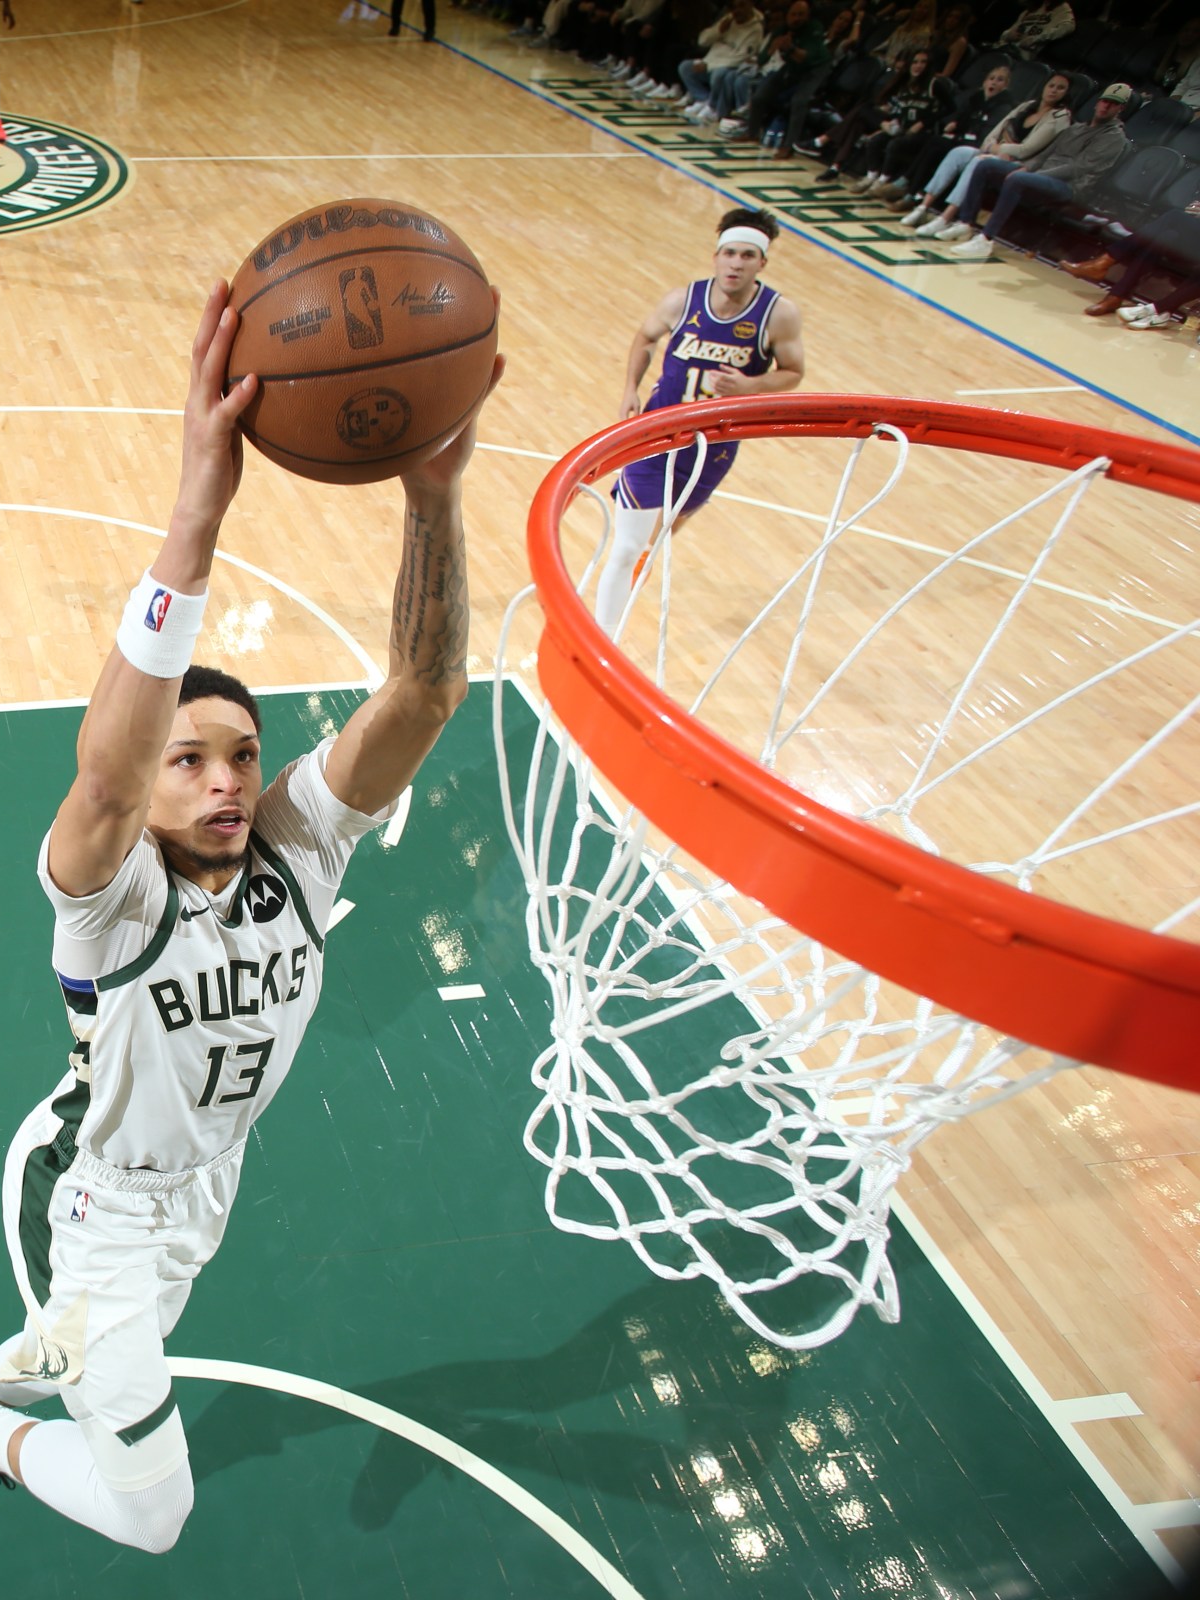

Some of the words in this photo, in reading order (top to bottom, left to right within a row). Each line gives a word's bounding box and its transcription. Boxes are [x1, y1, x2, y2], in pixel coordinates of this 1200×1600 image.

[635, 132, 806, 178] THE
[737, 184, 1007, 266] FEAR
[672, 332, 753, 368] LAKERS
[147, 943, 308, 1033] BUCKS
[196, 1036, 277, 1109] 13
